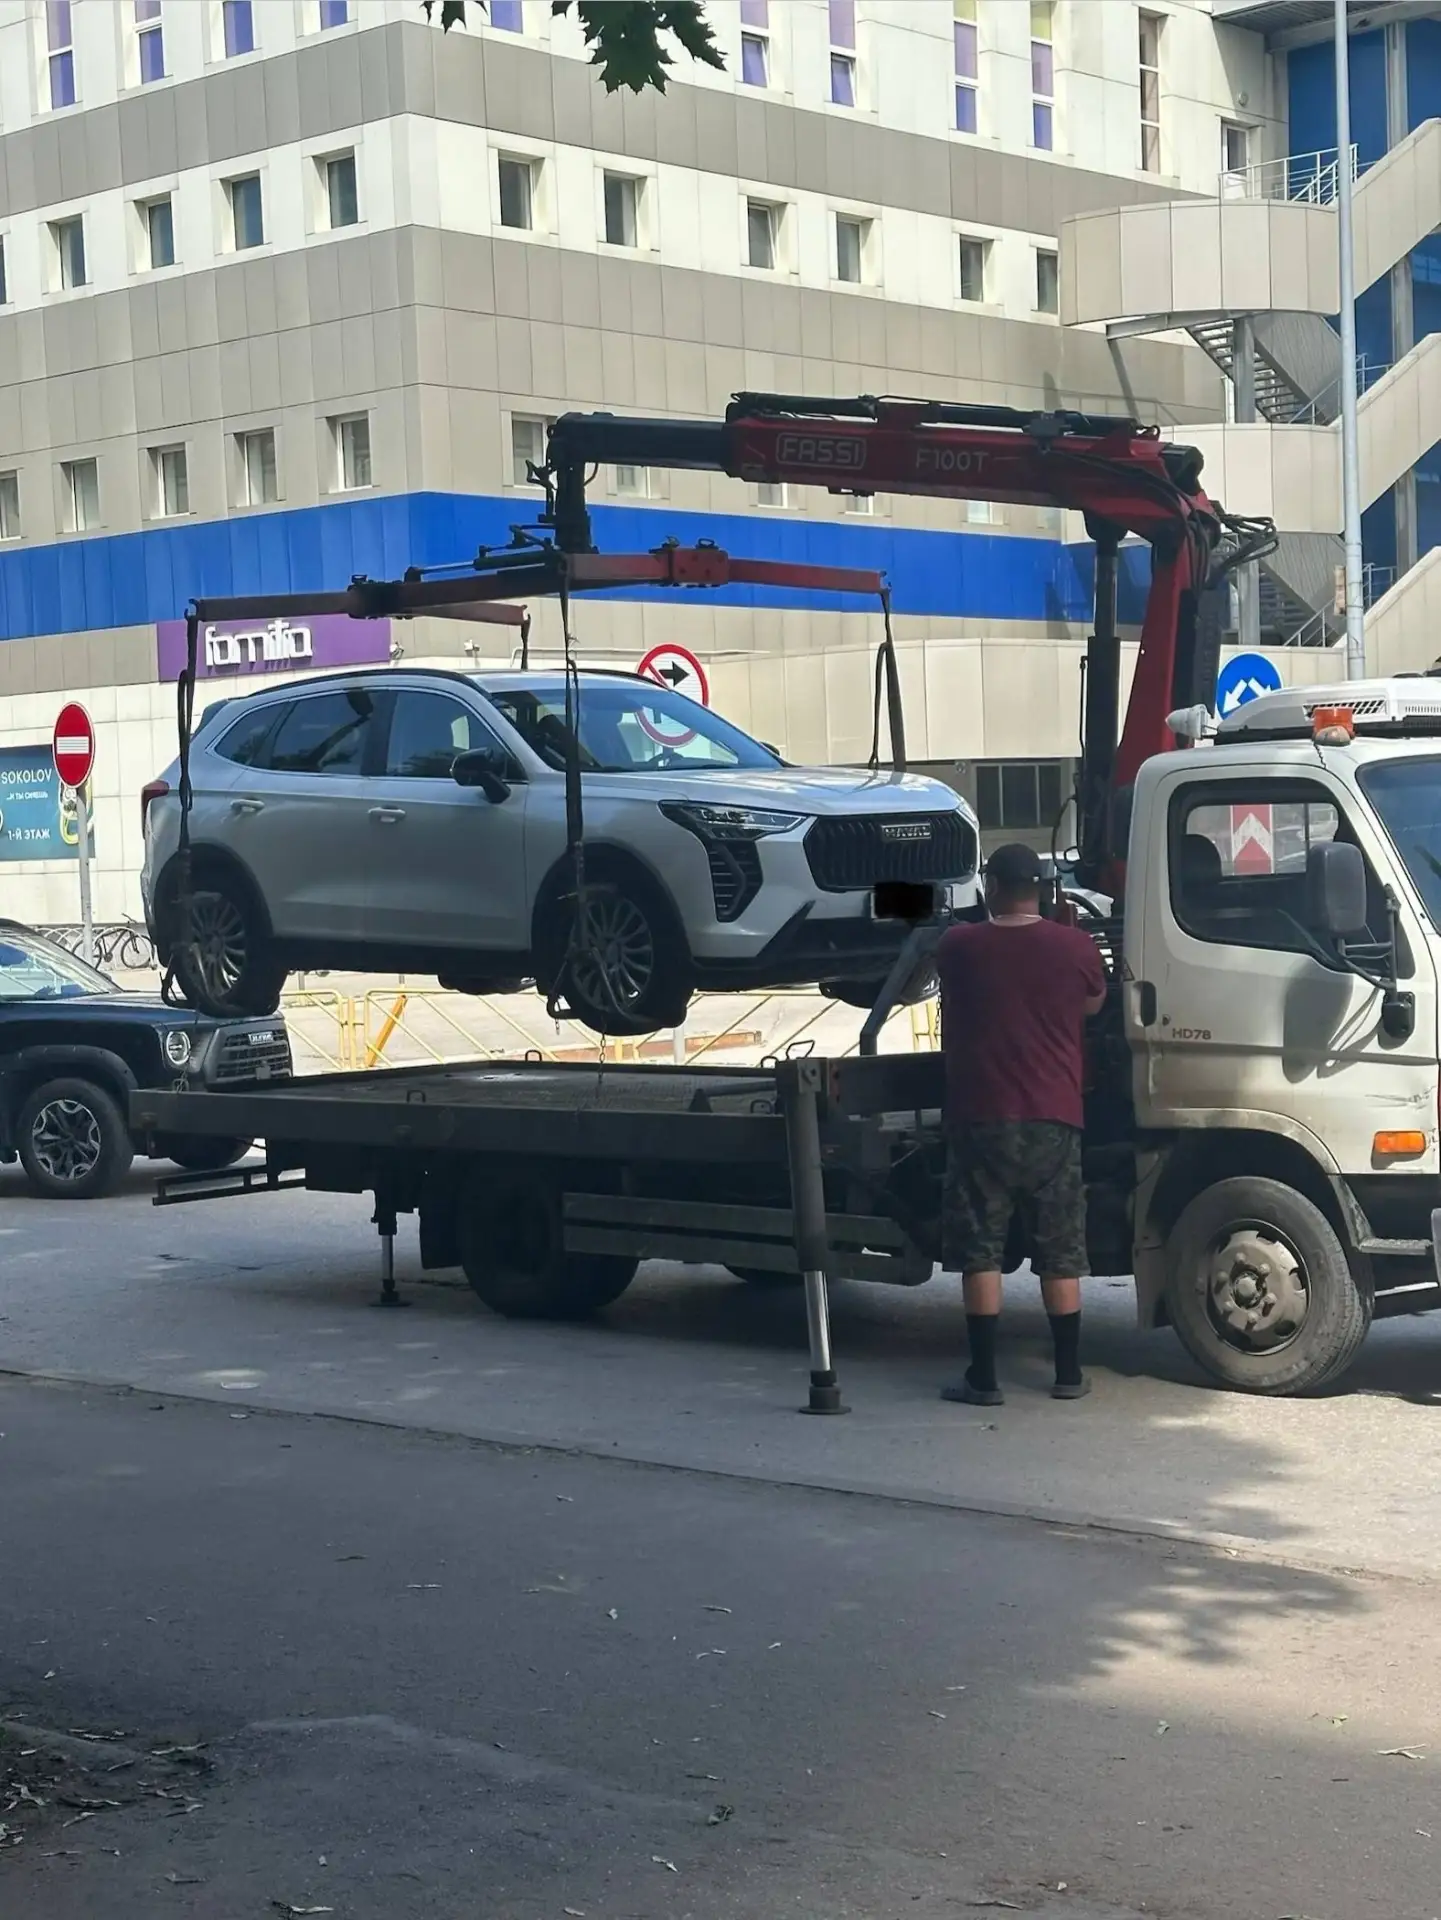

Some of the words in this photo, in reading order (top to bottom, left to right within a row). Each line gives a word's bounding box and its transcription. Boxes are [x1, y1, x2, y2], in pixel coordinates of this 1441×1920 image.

[783, 437, 860, 464] FASSI
[916, 449, 989, 473] F100T
[1, 768, 52, 784] SOKOLOV
[8, 828, 22, 841] 1-Й
[24, 828, 51, 841] ЭТАЖ
[1172, 1028, 1211, 1040] HD78
